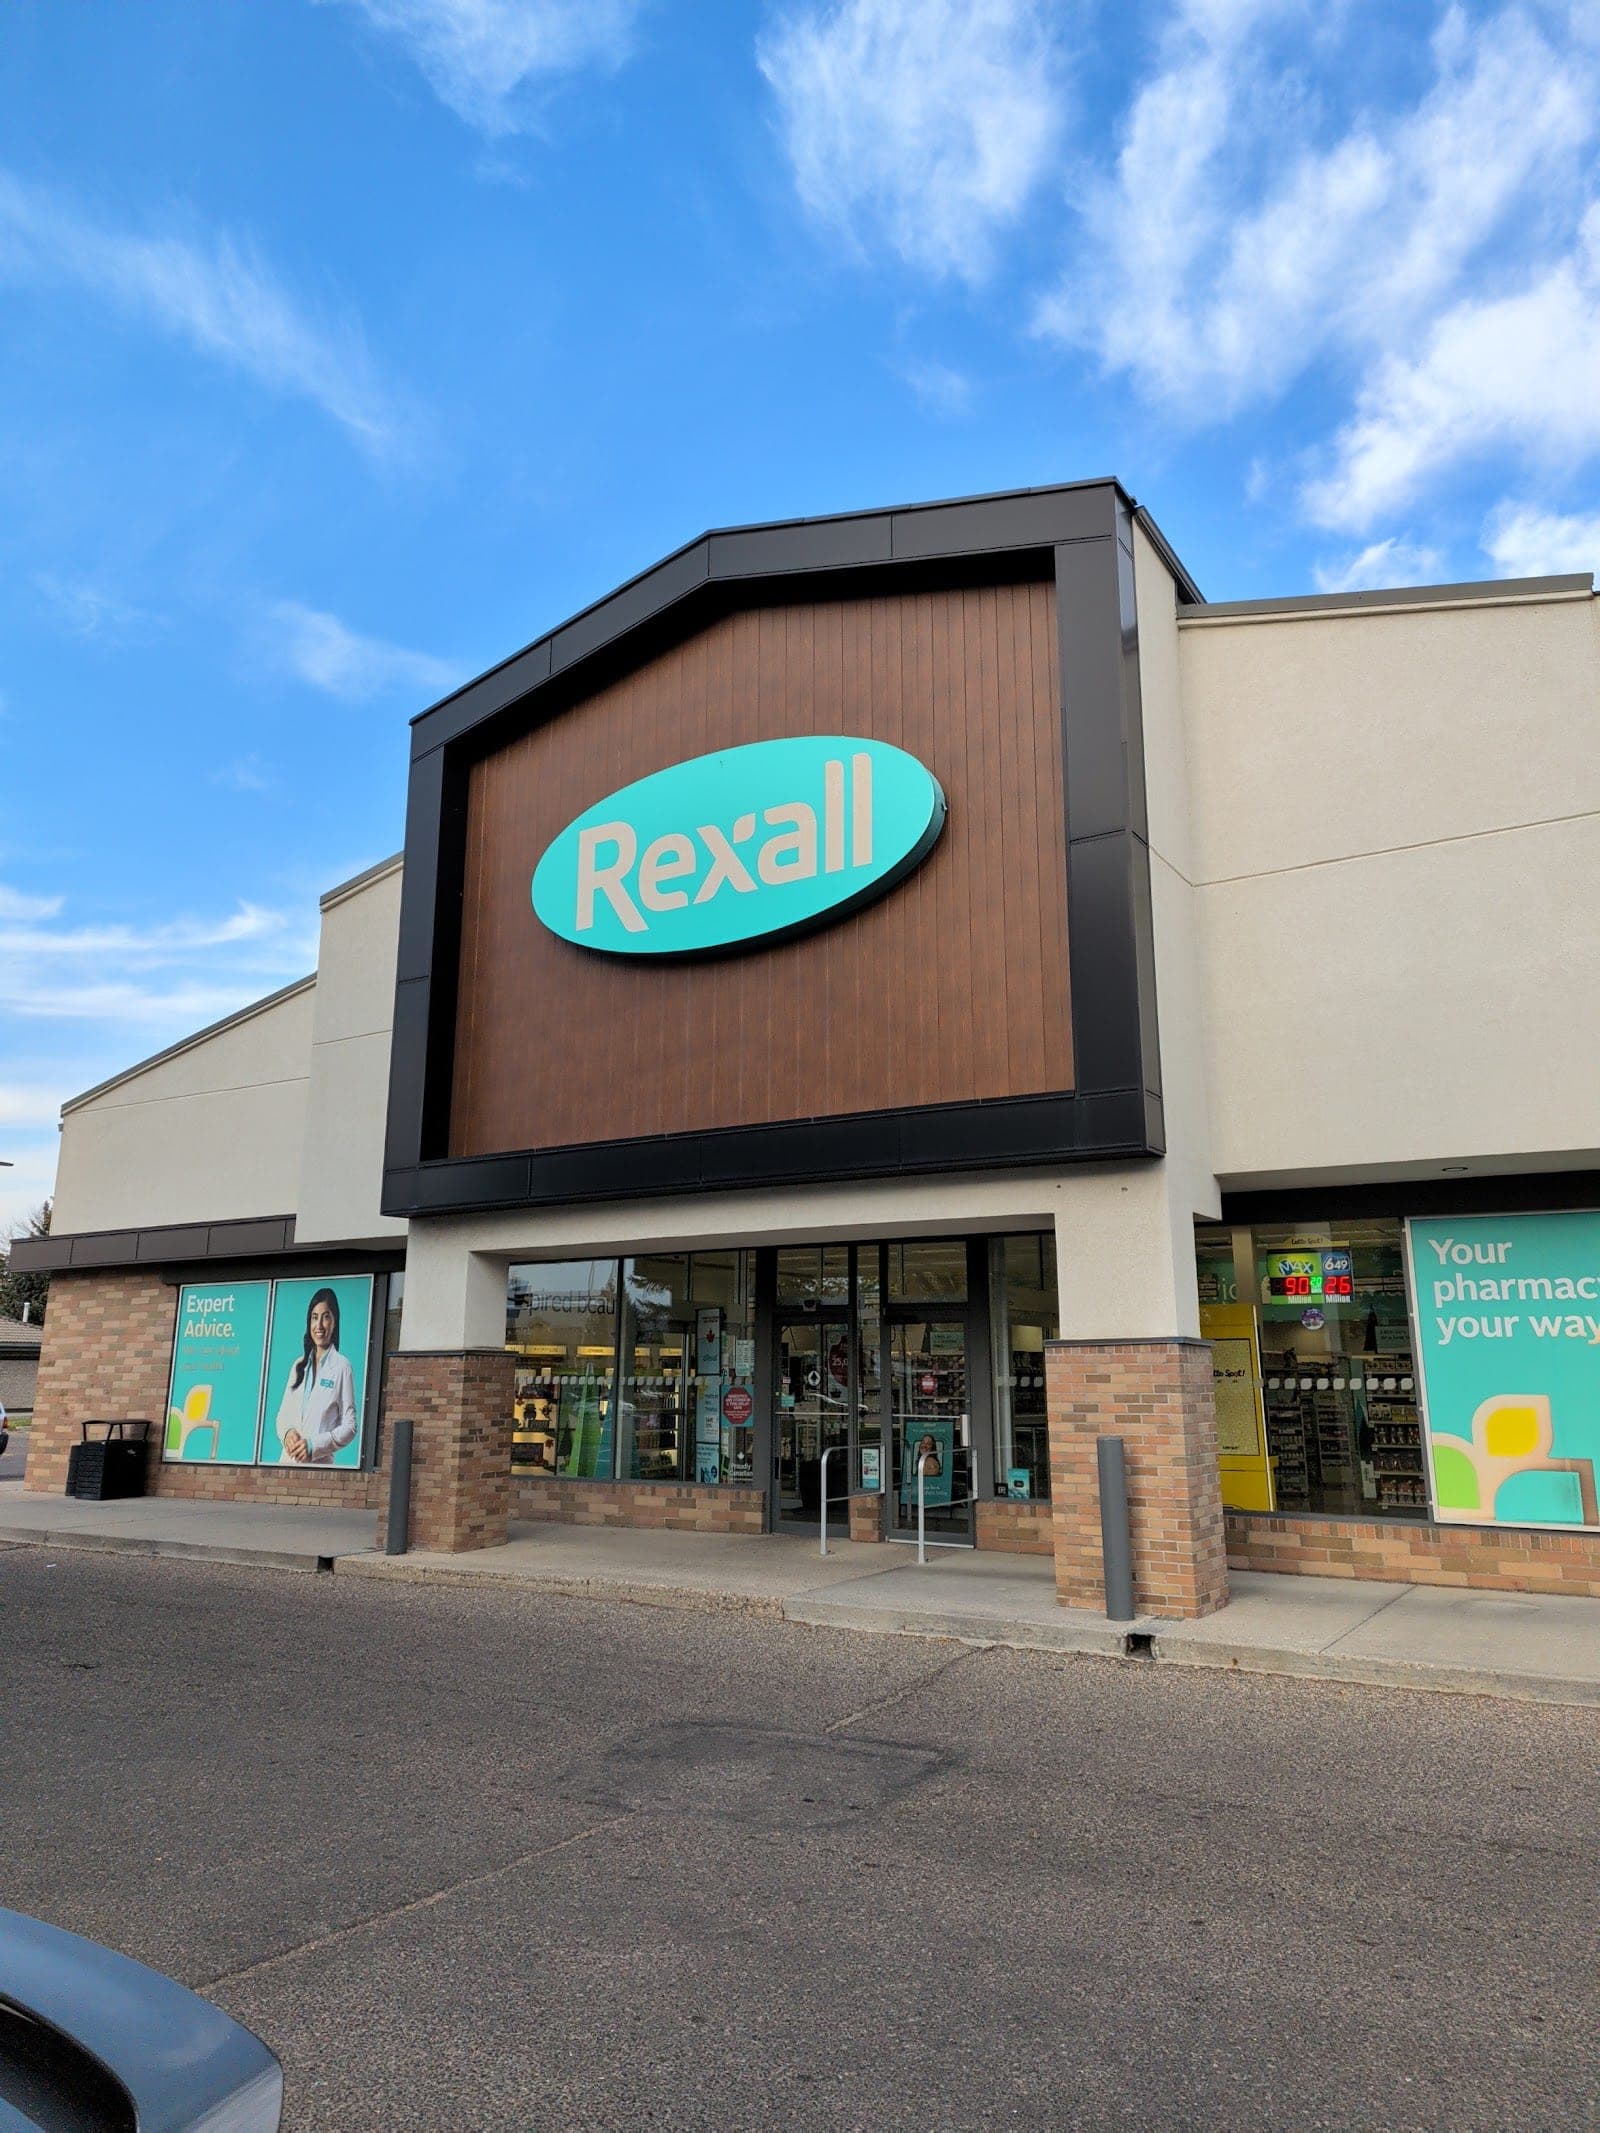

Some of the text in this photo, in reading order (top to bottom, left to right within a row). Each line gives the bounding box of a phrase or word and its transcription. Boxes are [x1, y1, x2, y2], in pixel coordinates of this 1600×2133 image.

[576, 752, 872, 932] Rexall
[1428, 1238, 1512, 1265] Your
[1278, 1259, 1314, 1275] MAX
[1285, 1277, 1310, 1295] 90
[1324, 1276, 1351, 1294] 26
[1433, 1272, 1600, 1309] pharmac
[186, 1294, 235, 1317] Expert
[1325, 1294, 1351, 1304] Million
[183, 1318, 235, 1338] Advice.
[1435, 1315, 1520, 1345] your
